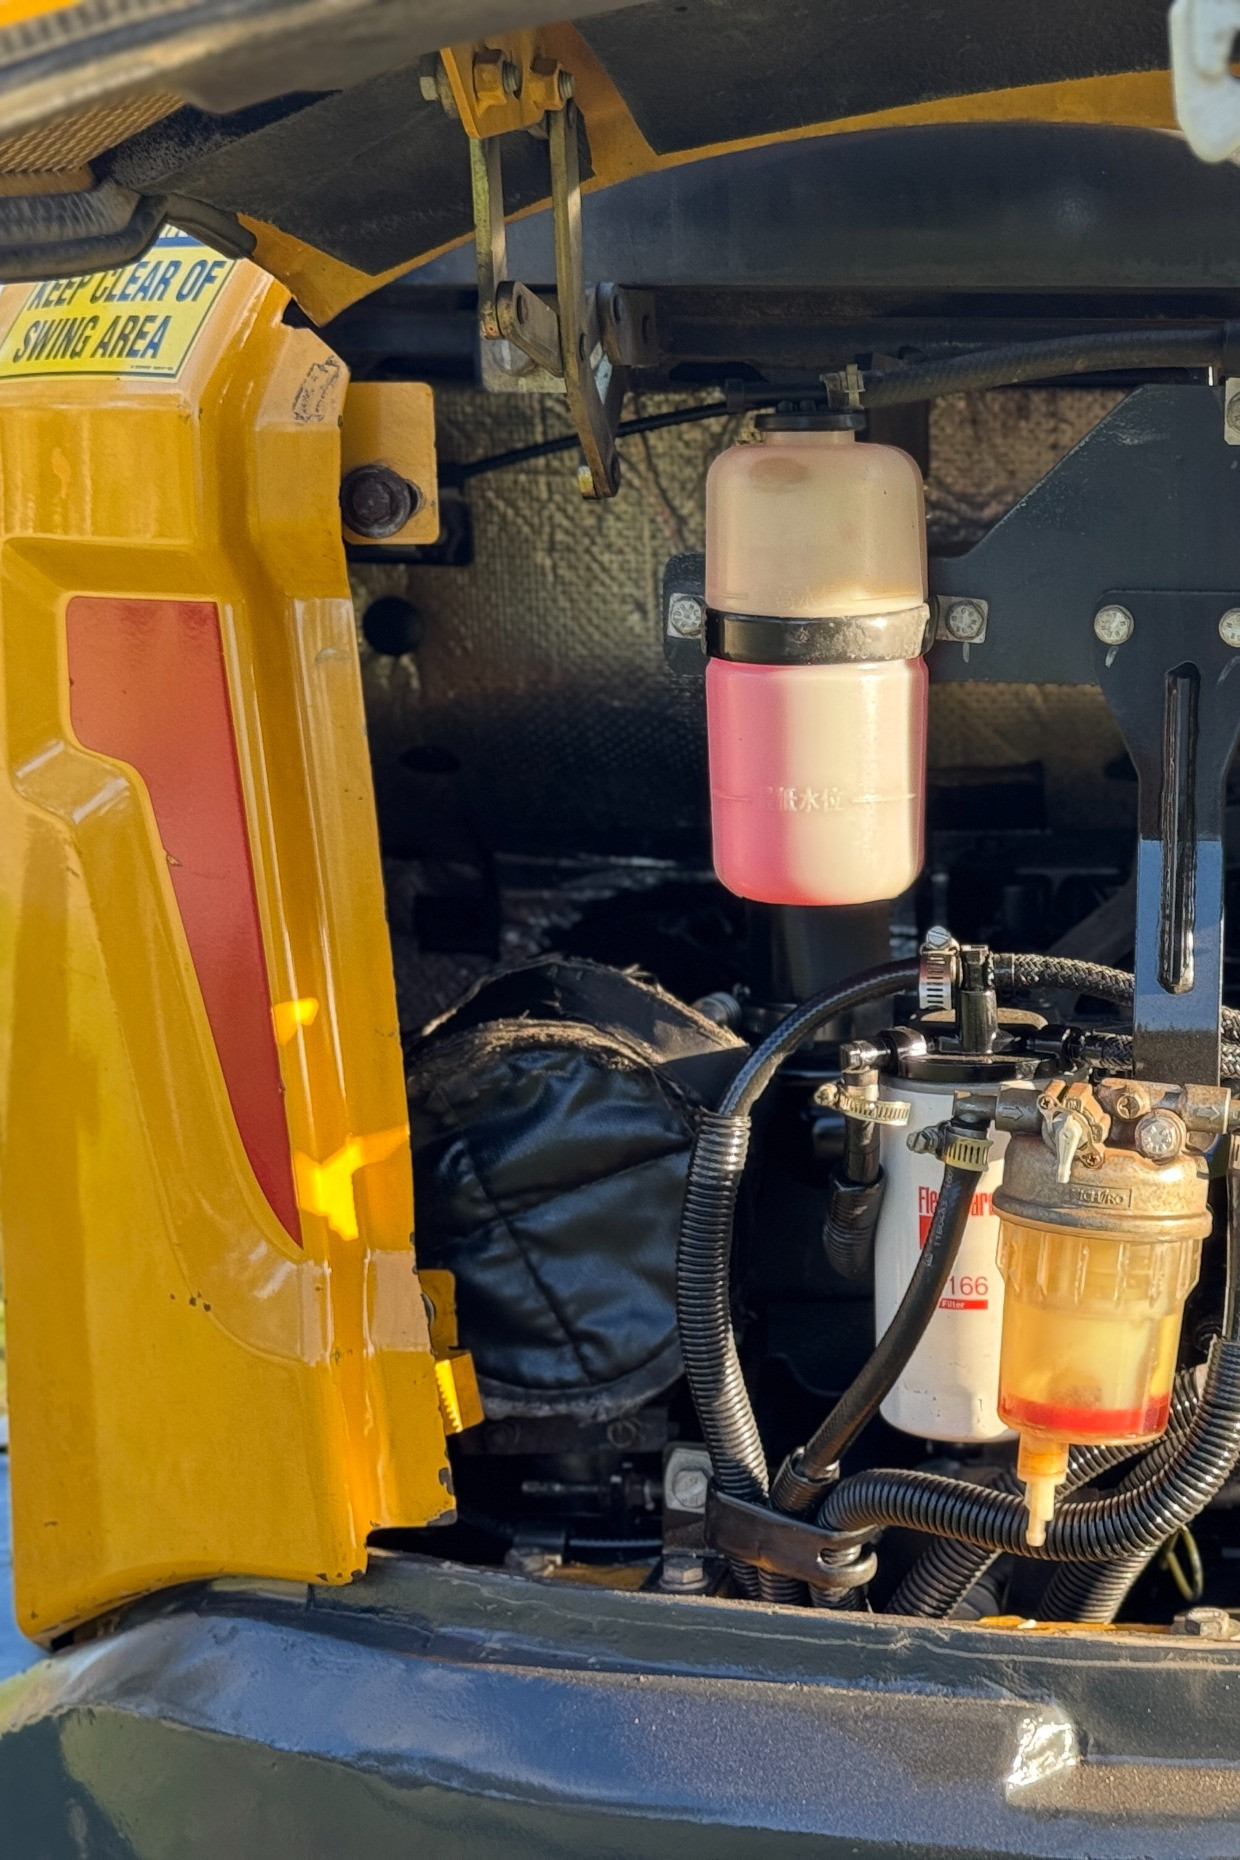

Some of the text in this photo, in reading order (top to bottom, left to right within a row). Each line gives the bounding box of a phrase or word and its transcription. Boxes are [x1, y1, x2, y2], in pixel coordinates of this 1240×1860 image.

[89, 260, 182, 303] CLEAR
[176, 260, 227, 302] OF
[13, 315, 172, 363] SWING AREA
